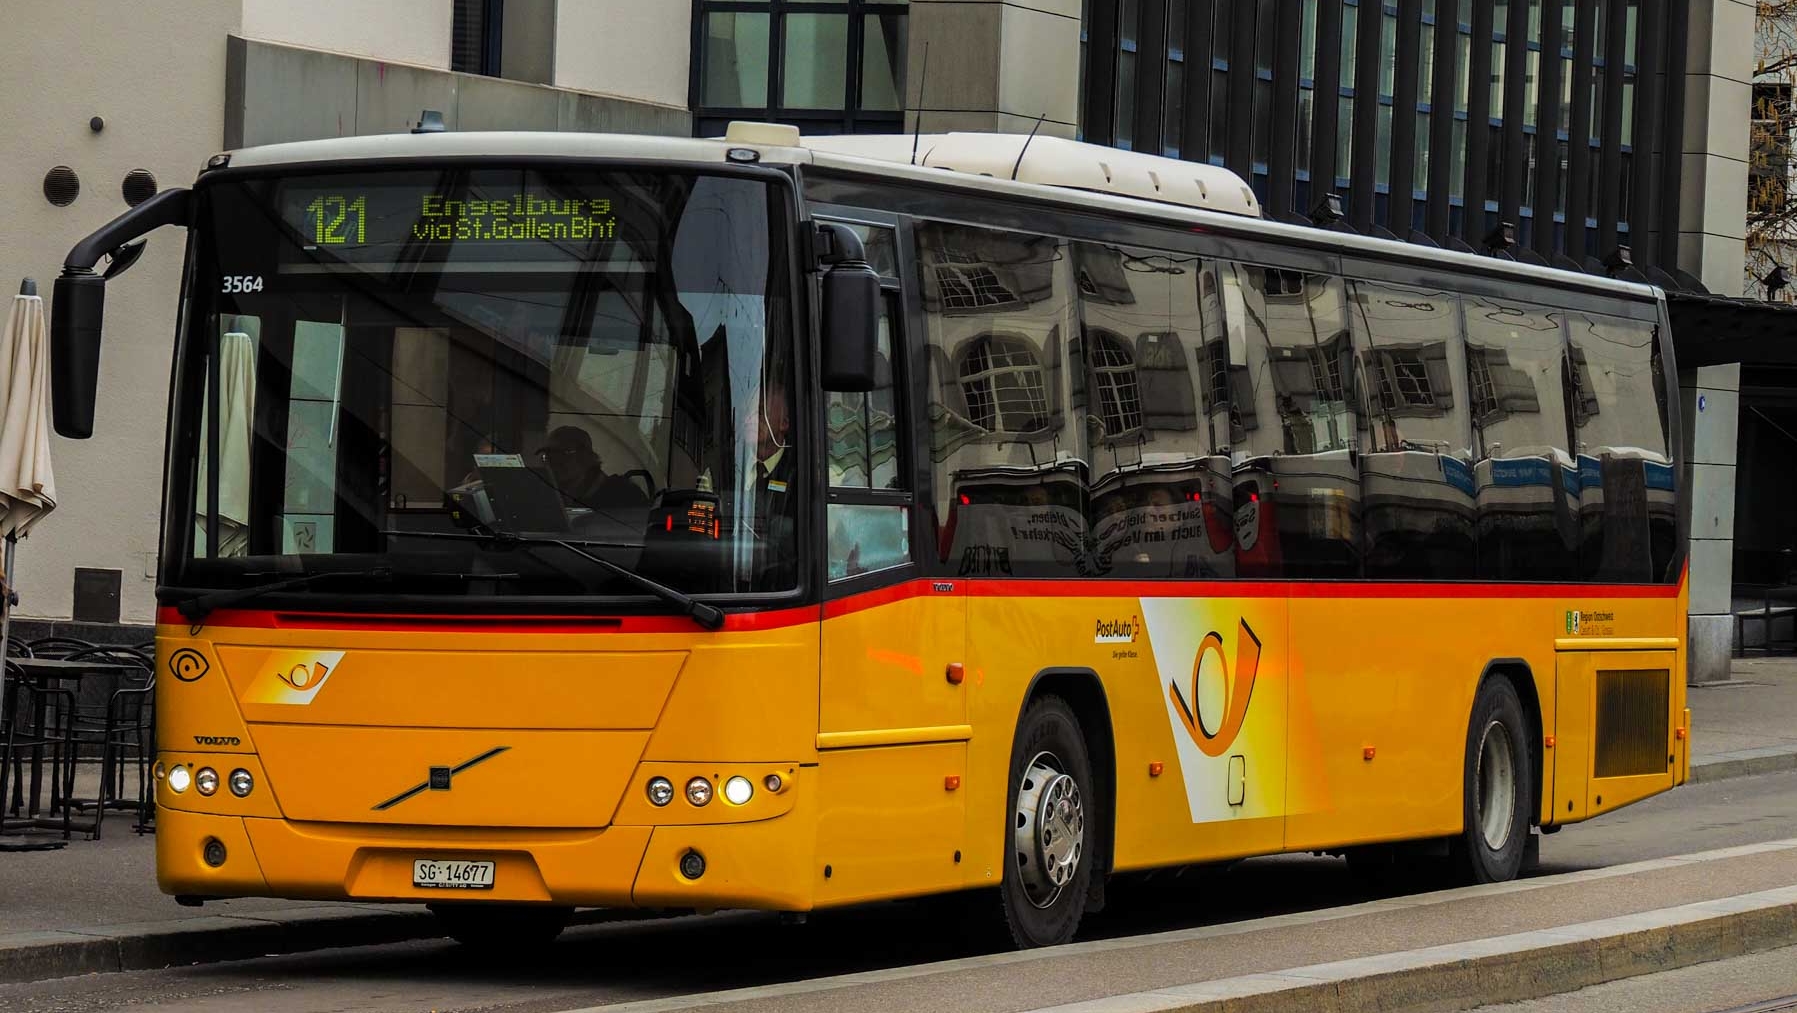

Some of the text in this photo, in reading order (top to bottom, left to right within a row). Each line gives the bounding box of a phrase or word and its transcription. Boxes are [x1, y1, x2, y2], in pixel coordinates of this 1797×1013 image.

[306, 196, 365, 243] 121
[413, 218, 451, 239] via
[222, 276, 264, 293] 3564
[1095, 619, 1132, 638] PostAuto
[193, 736, 241, 746] VOLVO
